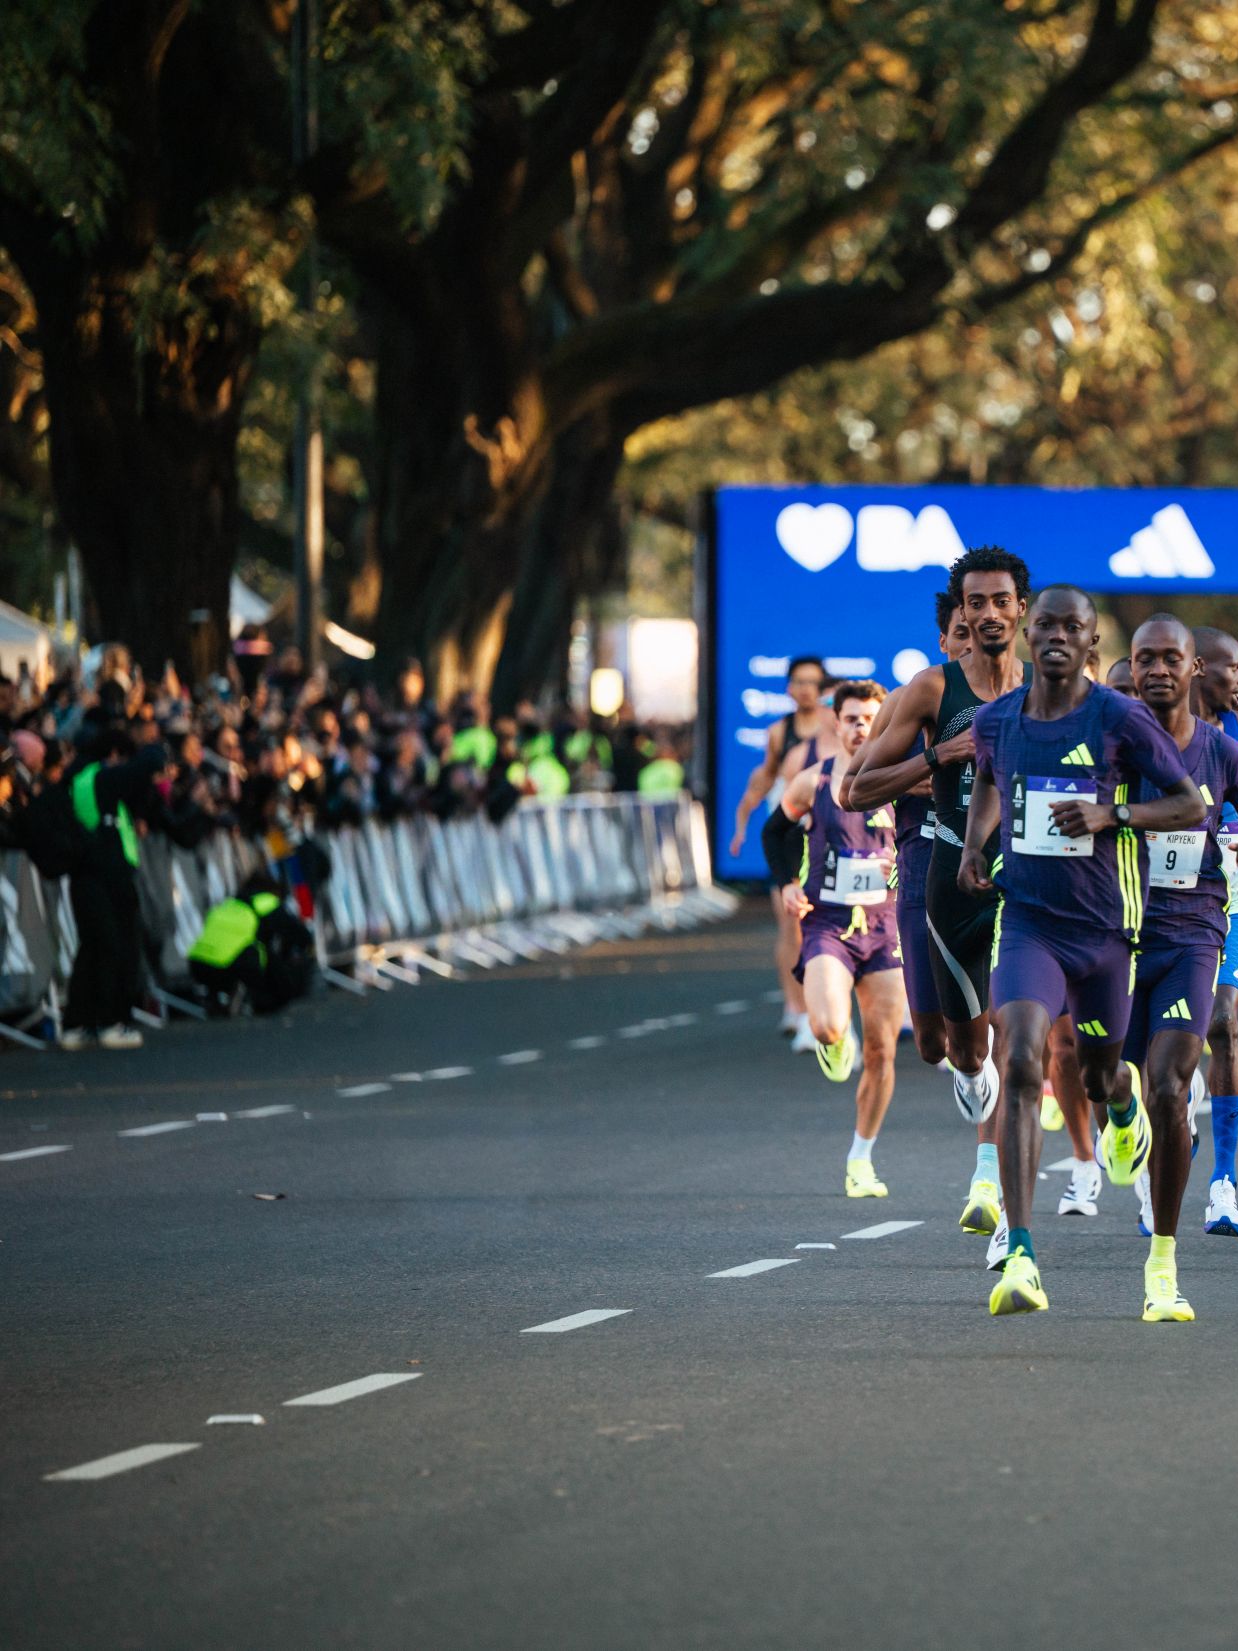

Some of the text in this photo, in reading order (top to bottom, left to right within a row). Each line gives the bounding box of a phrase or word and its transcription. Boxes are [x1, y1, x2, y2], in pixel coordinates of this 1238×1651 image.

[1015, 783, 1023, 799] A
[1166, 834, 1197, 845] KIPYEKO
[1165, 850, 1177, 871] 9
[853, 874, 871, 890] 21
